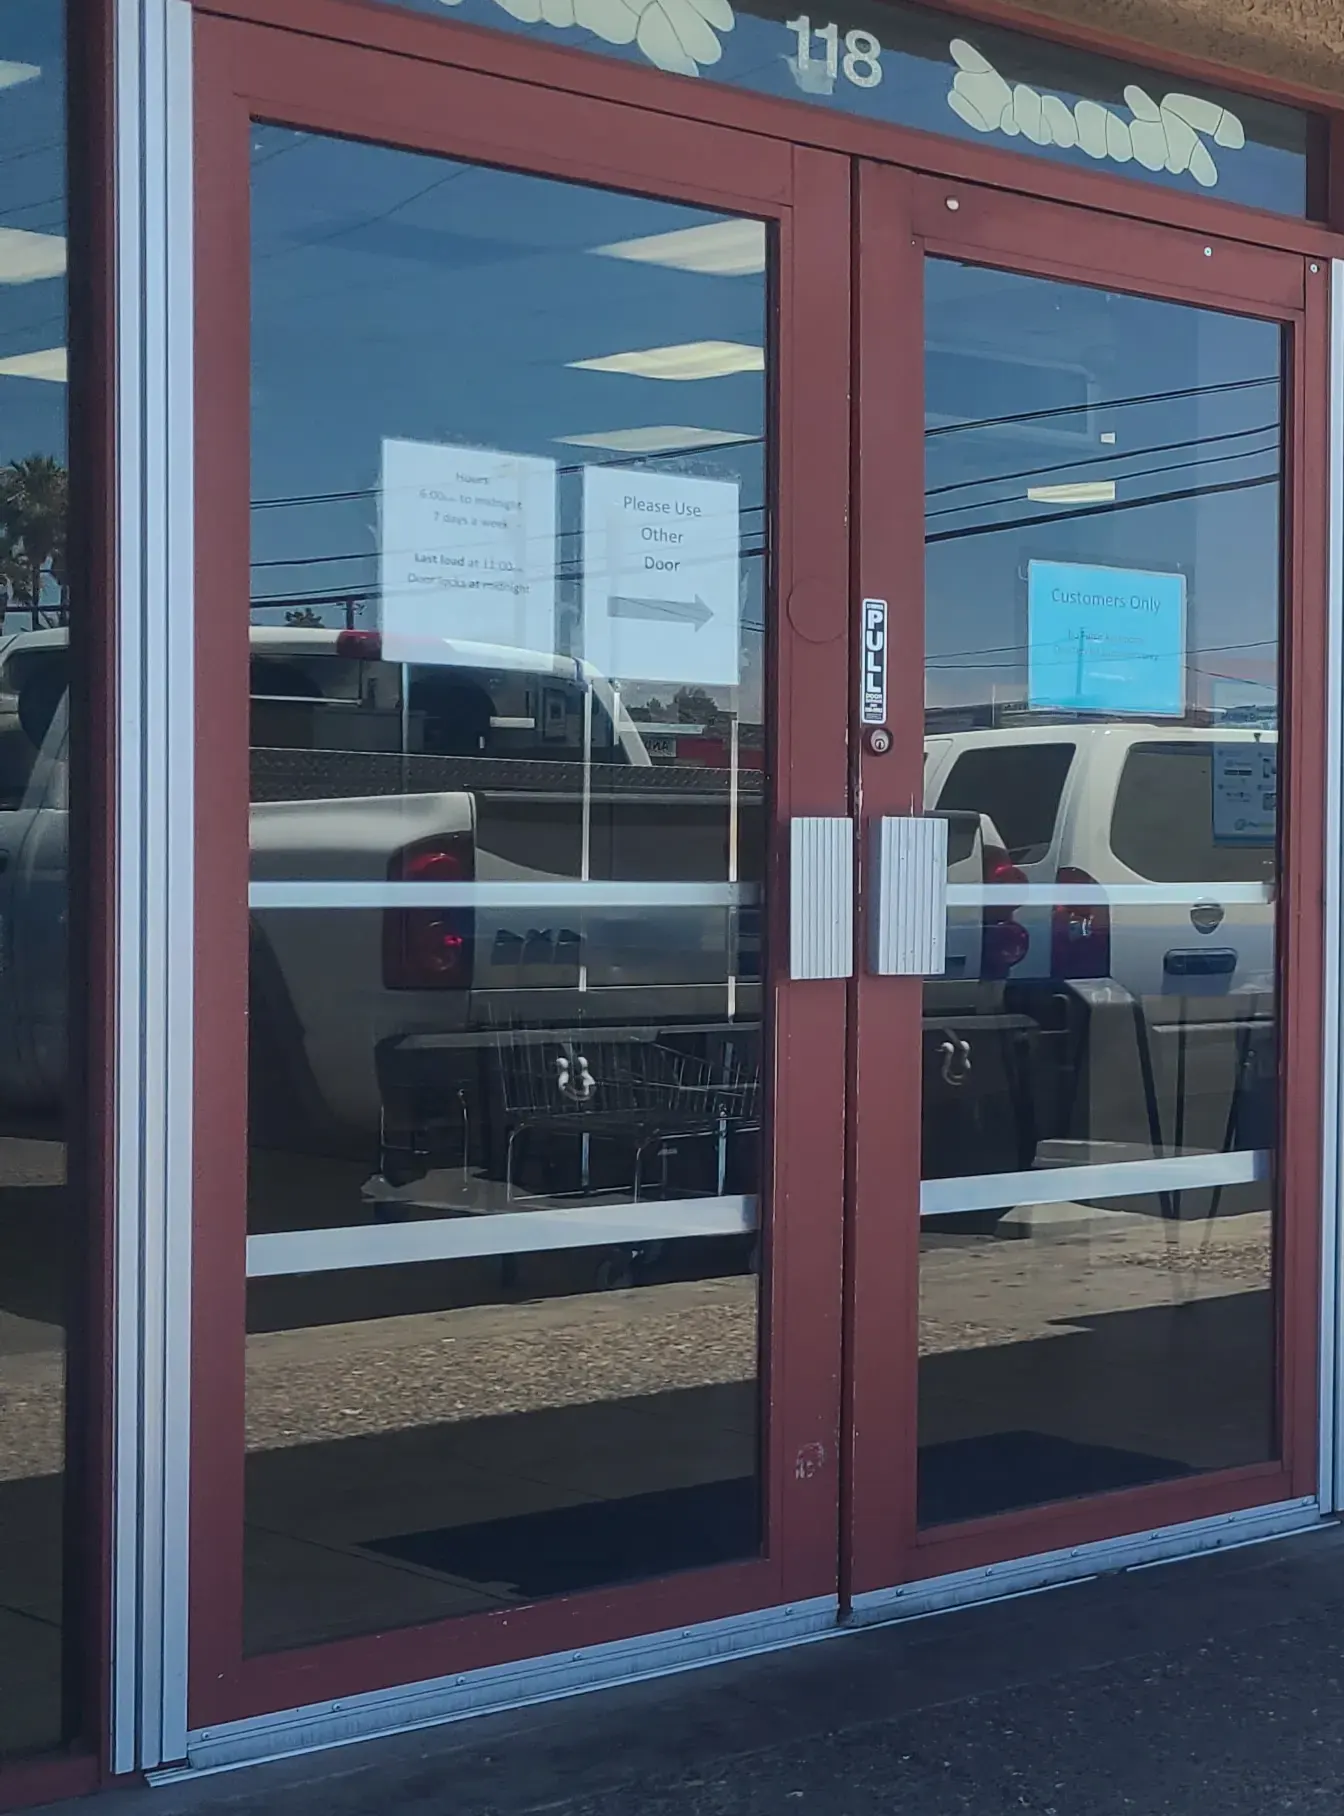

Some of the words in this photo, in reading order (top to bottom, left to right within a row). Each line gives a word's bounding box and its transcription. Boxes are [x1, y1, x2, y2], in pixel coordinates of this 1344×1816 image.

[786, 14, 884, 88] 118
[460, 493, 472, 505] to
[623, 496, 671, 515] Please
[675, 502, 702, 517] Use
[641, 527, 684, 544] Other
[644, 556, 681, 572] Door
[1051, 588, 1127, 609] Customers
[1130, 595, 1161, 616] Only
[866, 609, 884, 693] PULL
